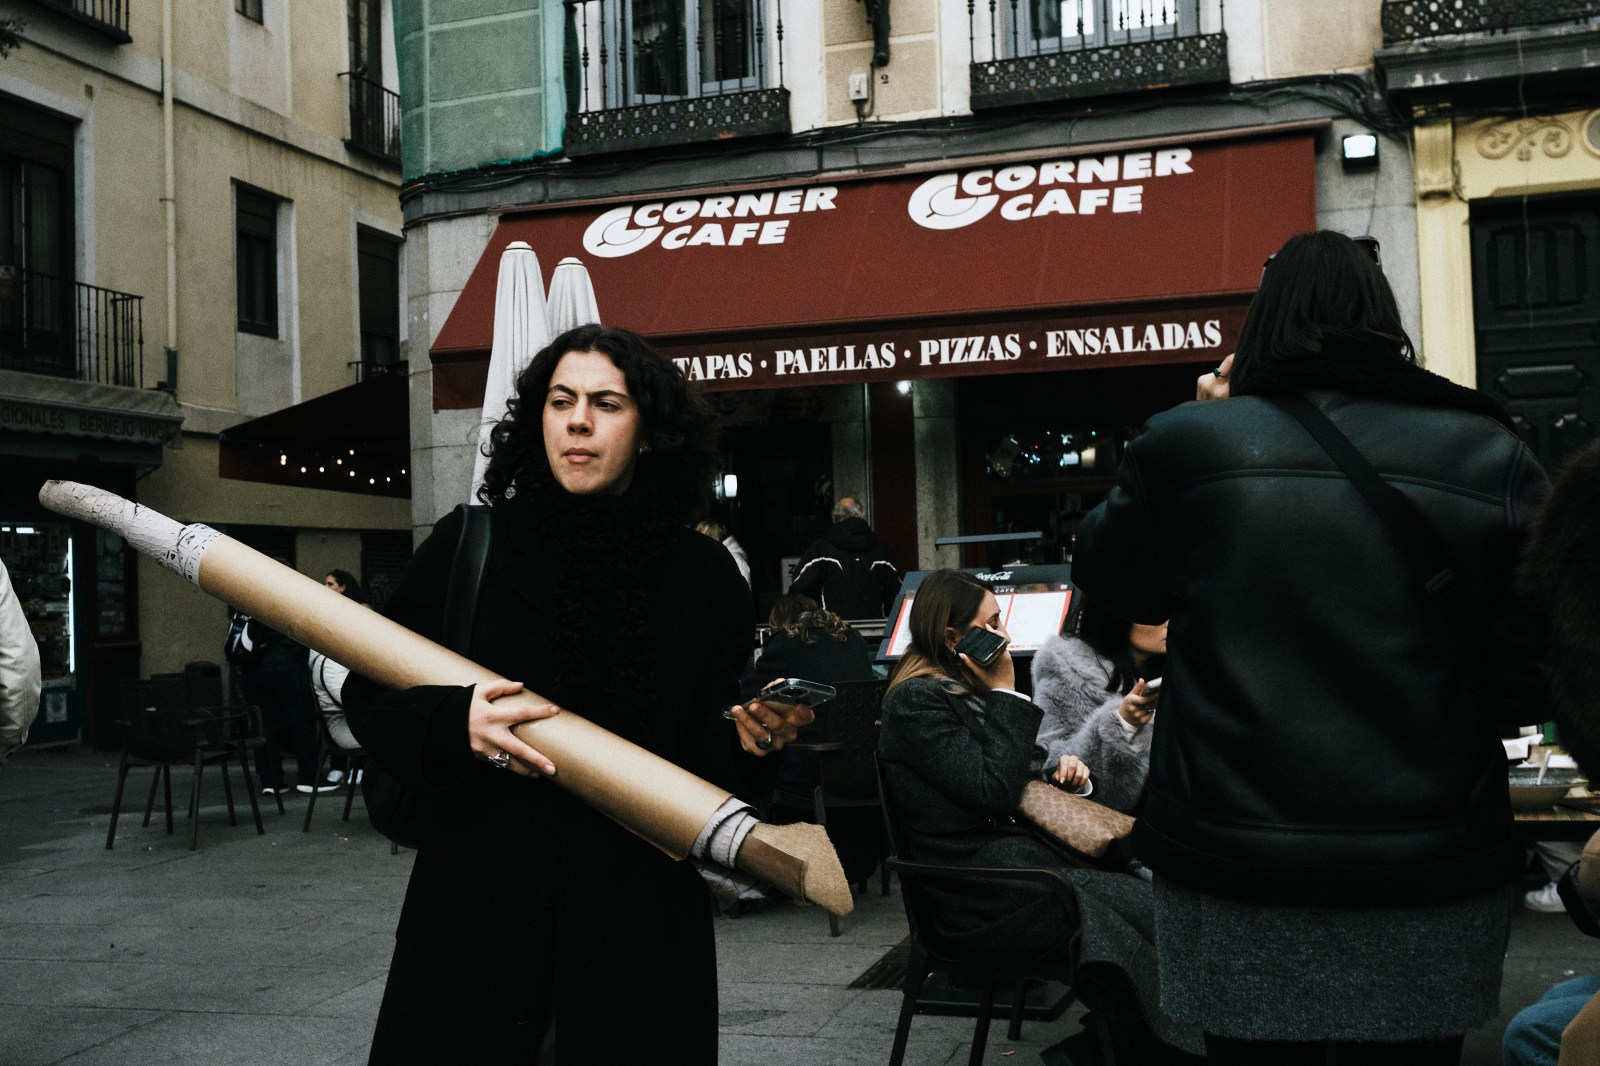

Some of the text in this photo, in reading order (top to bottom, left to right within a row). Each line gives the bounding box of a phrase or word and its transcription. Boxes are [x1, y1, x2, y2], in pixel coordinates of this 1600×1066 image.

[973, 148, 1194, 196] CORNER
[634, 186, 838, 227] CORNER
[1000, 185, 1144, 221] CAFE
[661, 220, 790, 250] CAFE
[672, 319, 1222, 381] TAPAS PAELLAS PIZZAS ENSALADAS
[79, 415, 135, 437] BERMEJO
